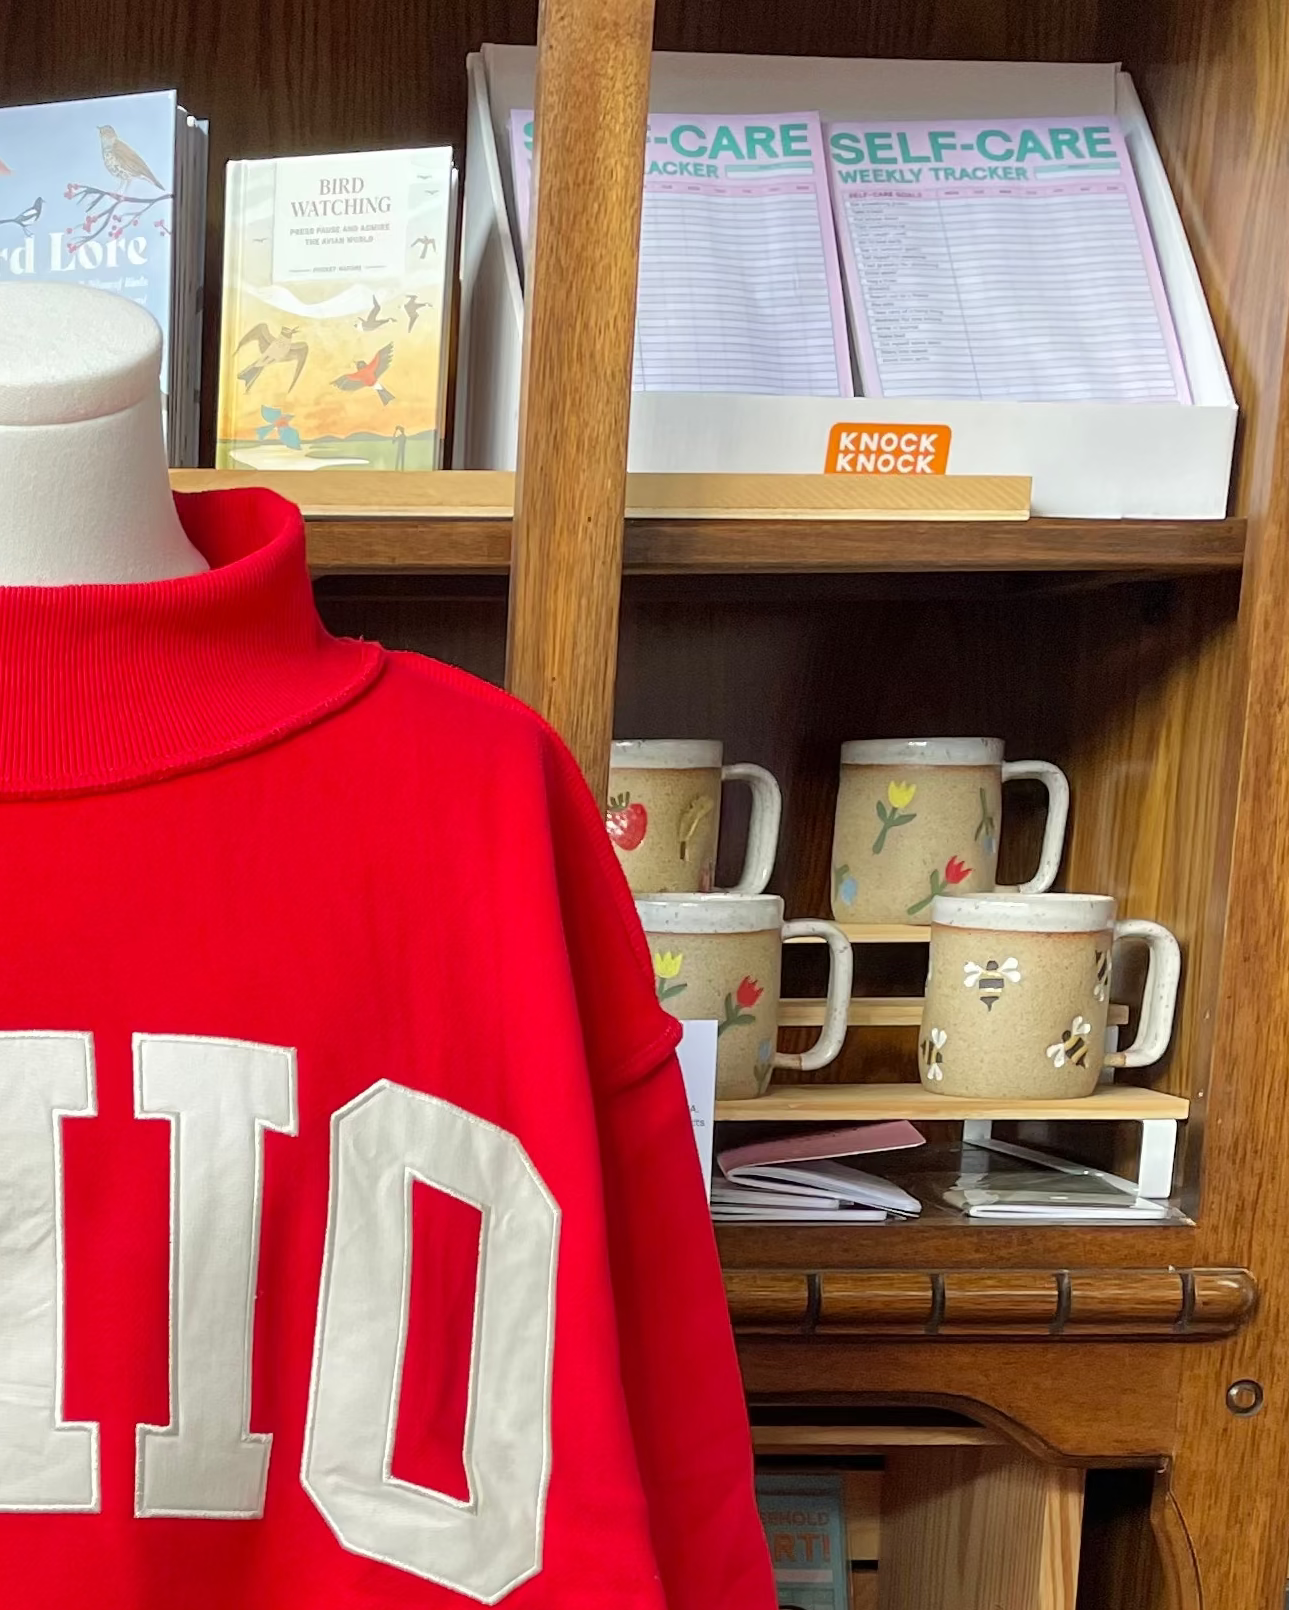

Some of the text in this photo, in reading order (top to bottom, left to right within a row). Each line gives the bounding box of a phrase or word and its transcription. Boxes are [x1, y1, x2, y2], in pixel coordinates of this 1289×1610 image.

[829, 126, 1117, 166] SELF-CARE
[838, 166, 1028, 184] WEEKLY TRACKER
[319, 177, 365, 196] BIRD
[290, 196, 392, 218] WATCHING
[48, 231, 149, 273] Lore
[839, 431, 939, 453] KNOCK
[835, 452, 936, 474] KNOCK
[773, 1532, 831, 1562] RT!
